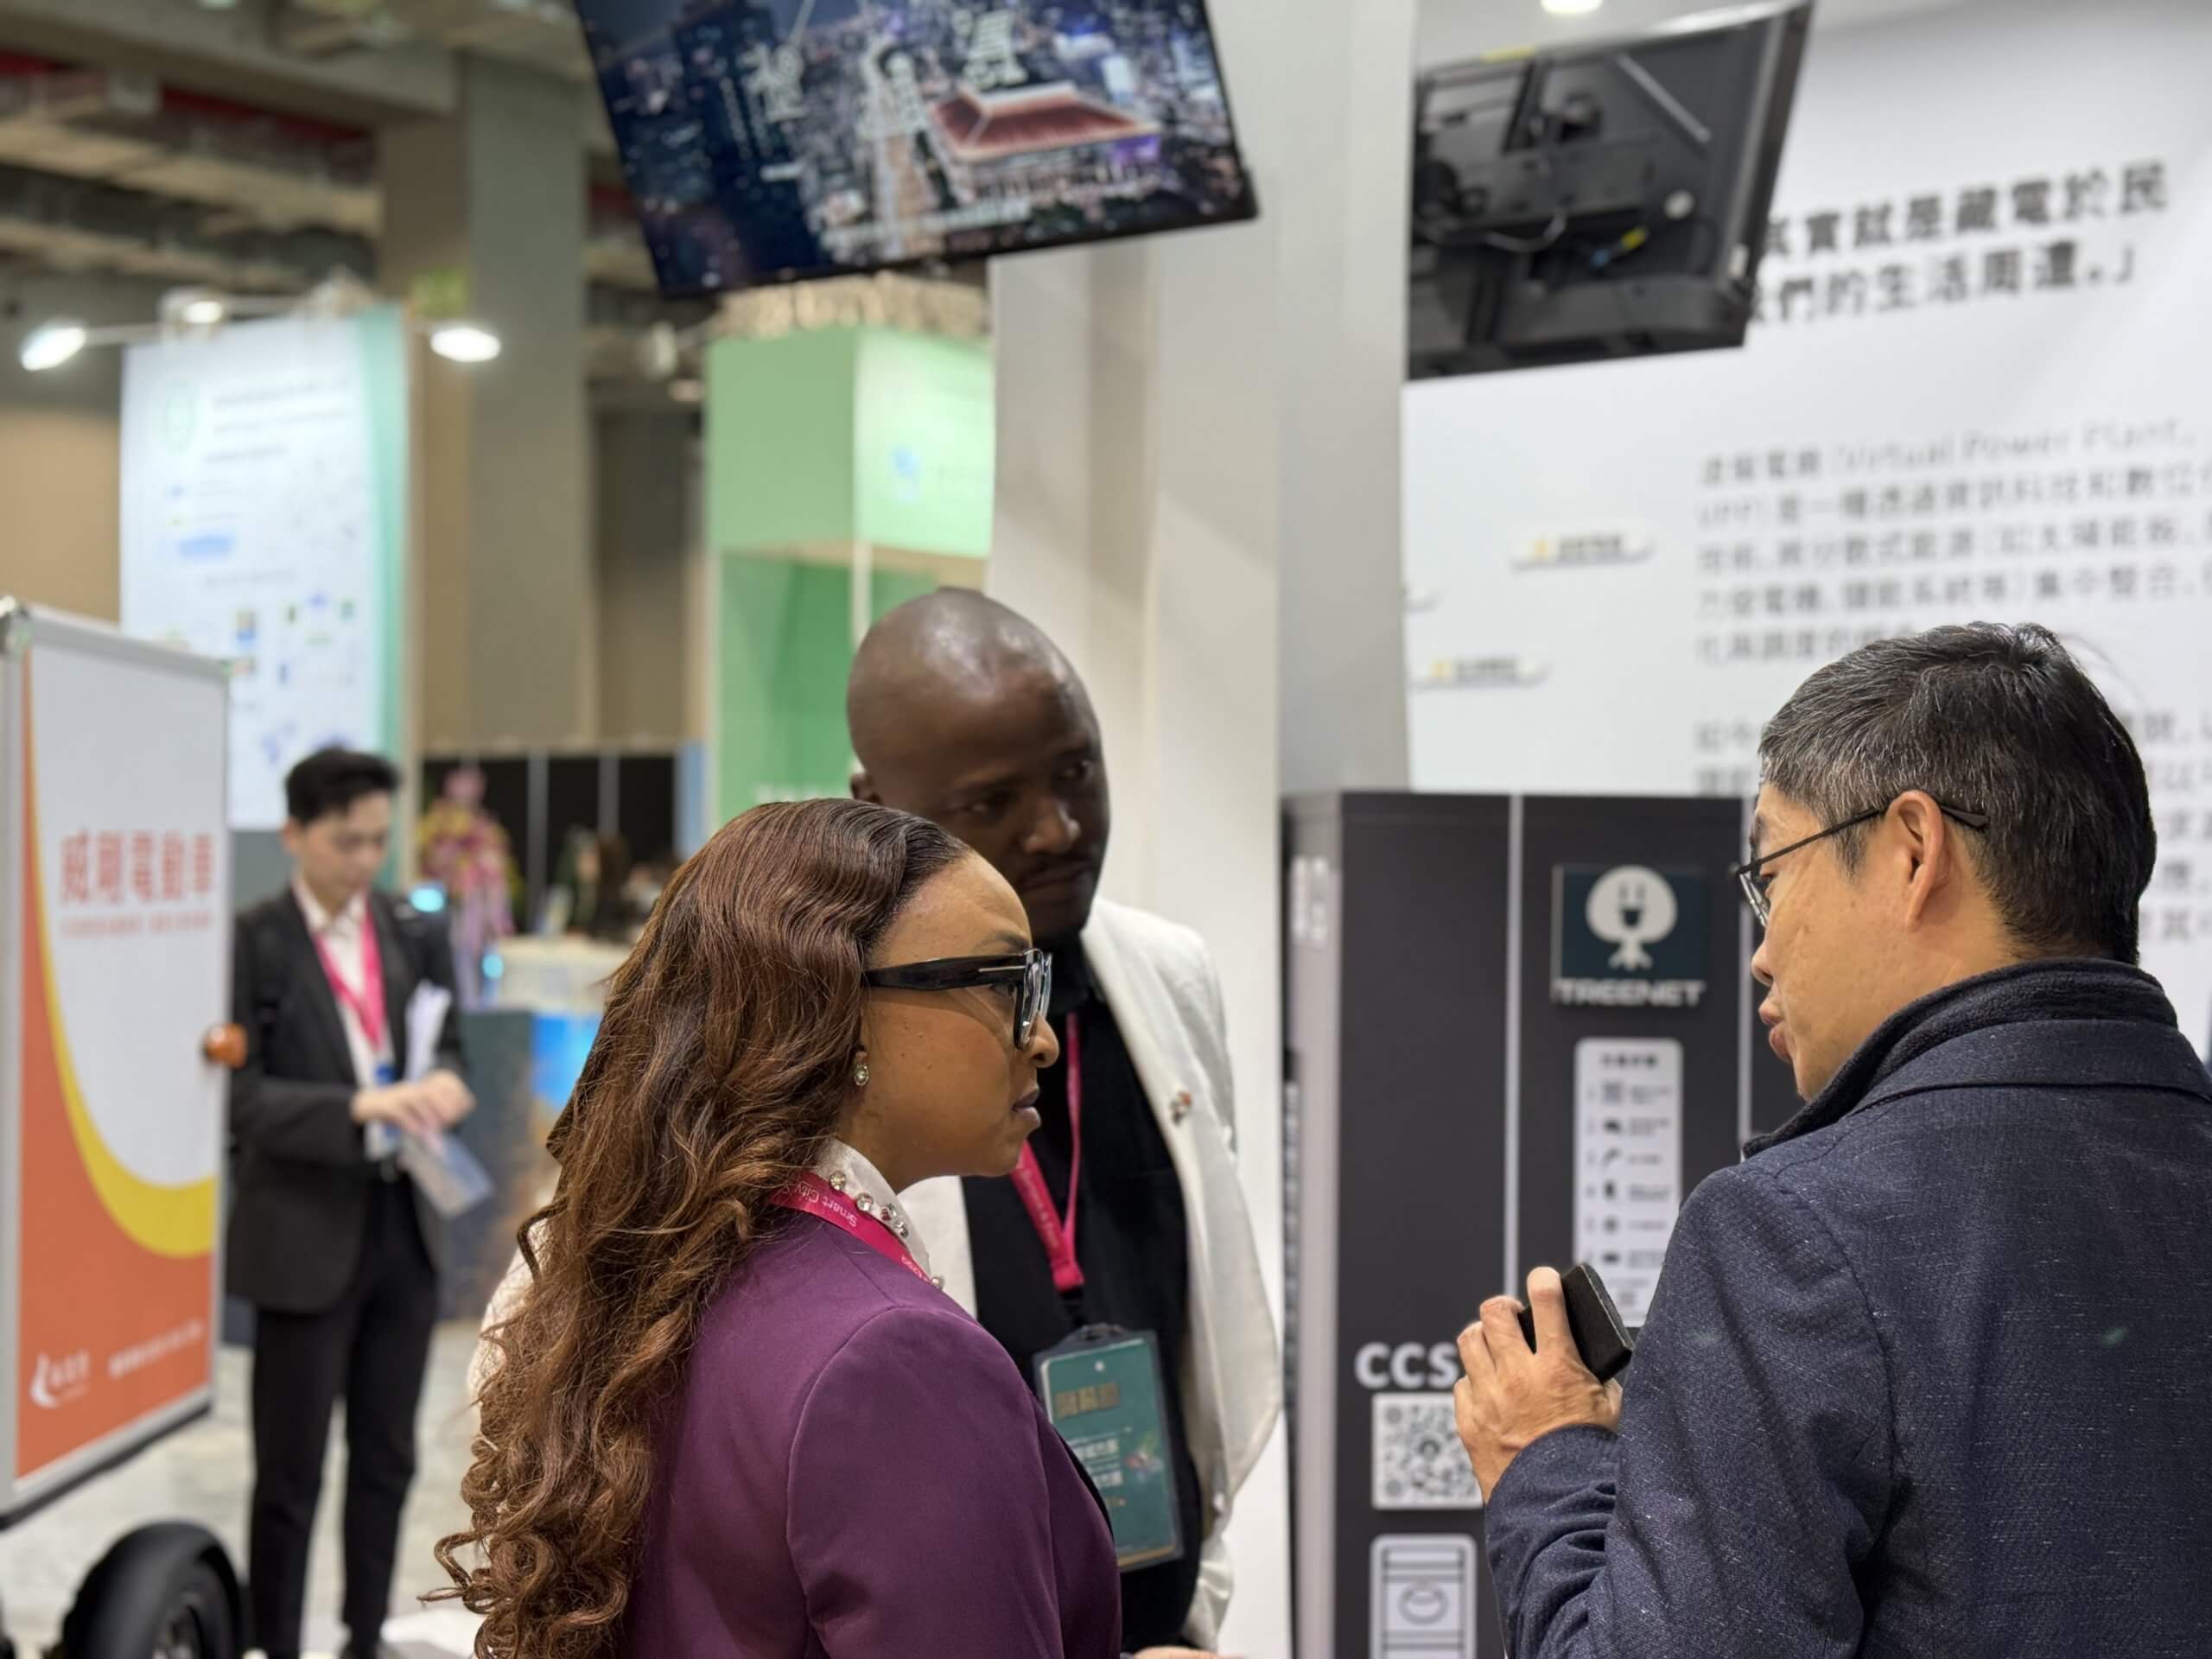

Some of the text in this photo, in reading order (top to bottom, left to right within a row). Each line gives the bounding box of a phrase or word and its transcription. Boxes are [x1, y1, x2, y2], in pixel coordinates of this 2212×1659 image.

[795, 1180, 820, 1203] City
[822, 1193, 858, 1228] Smart
[1355, 1342, 1459, 1389] CCS
